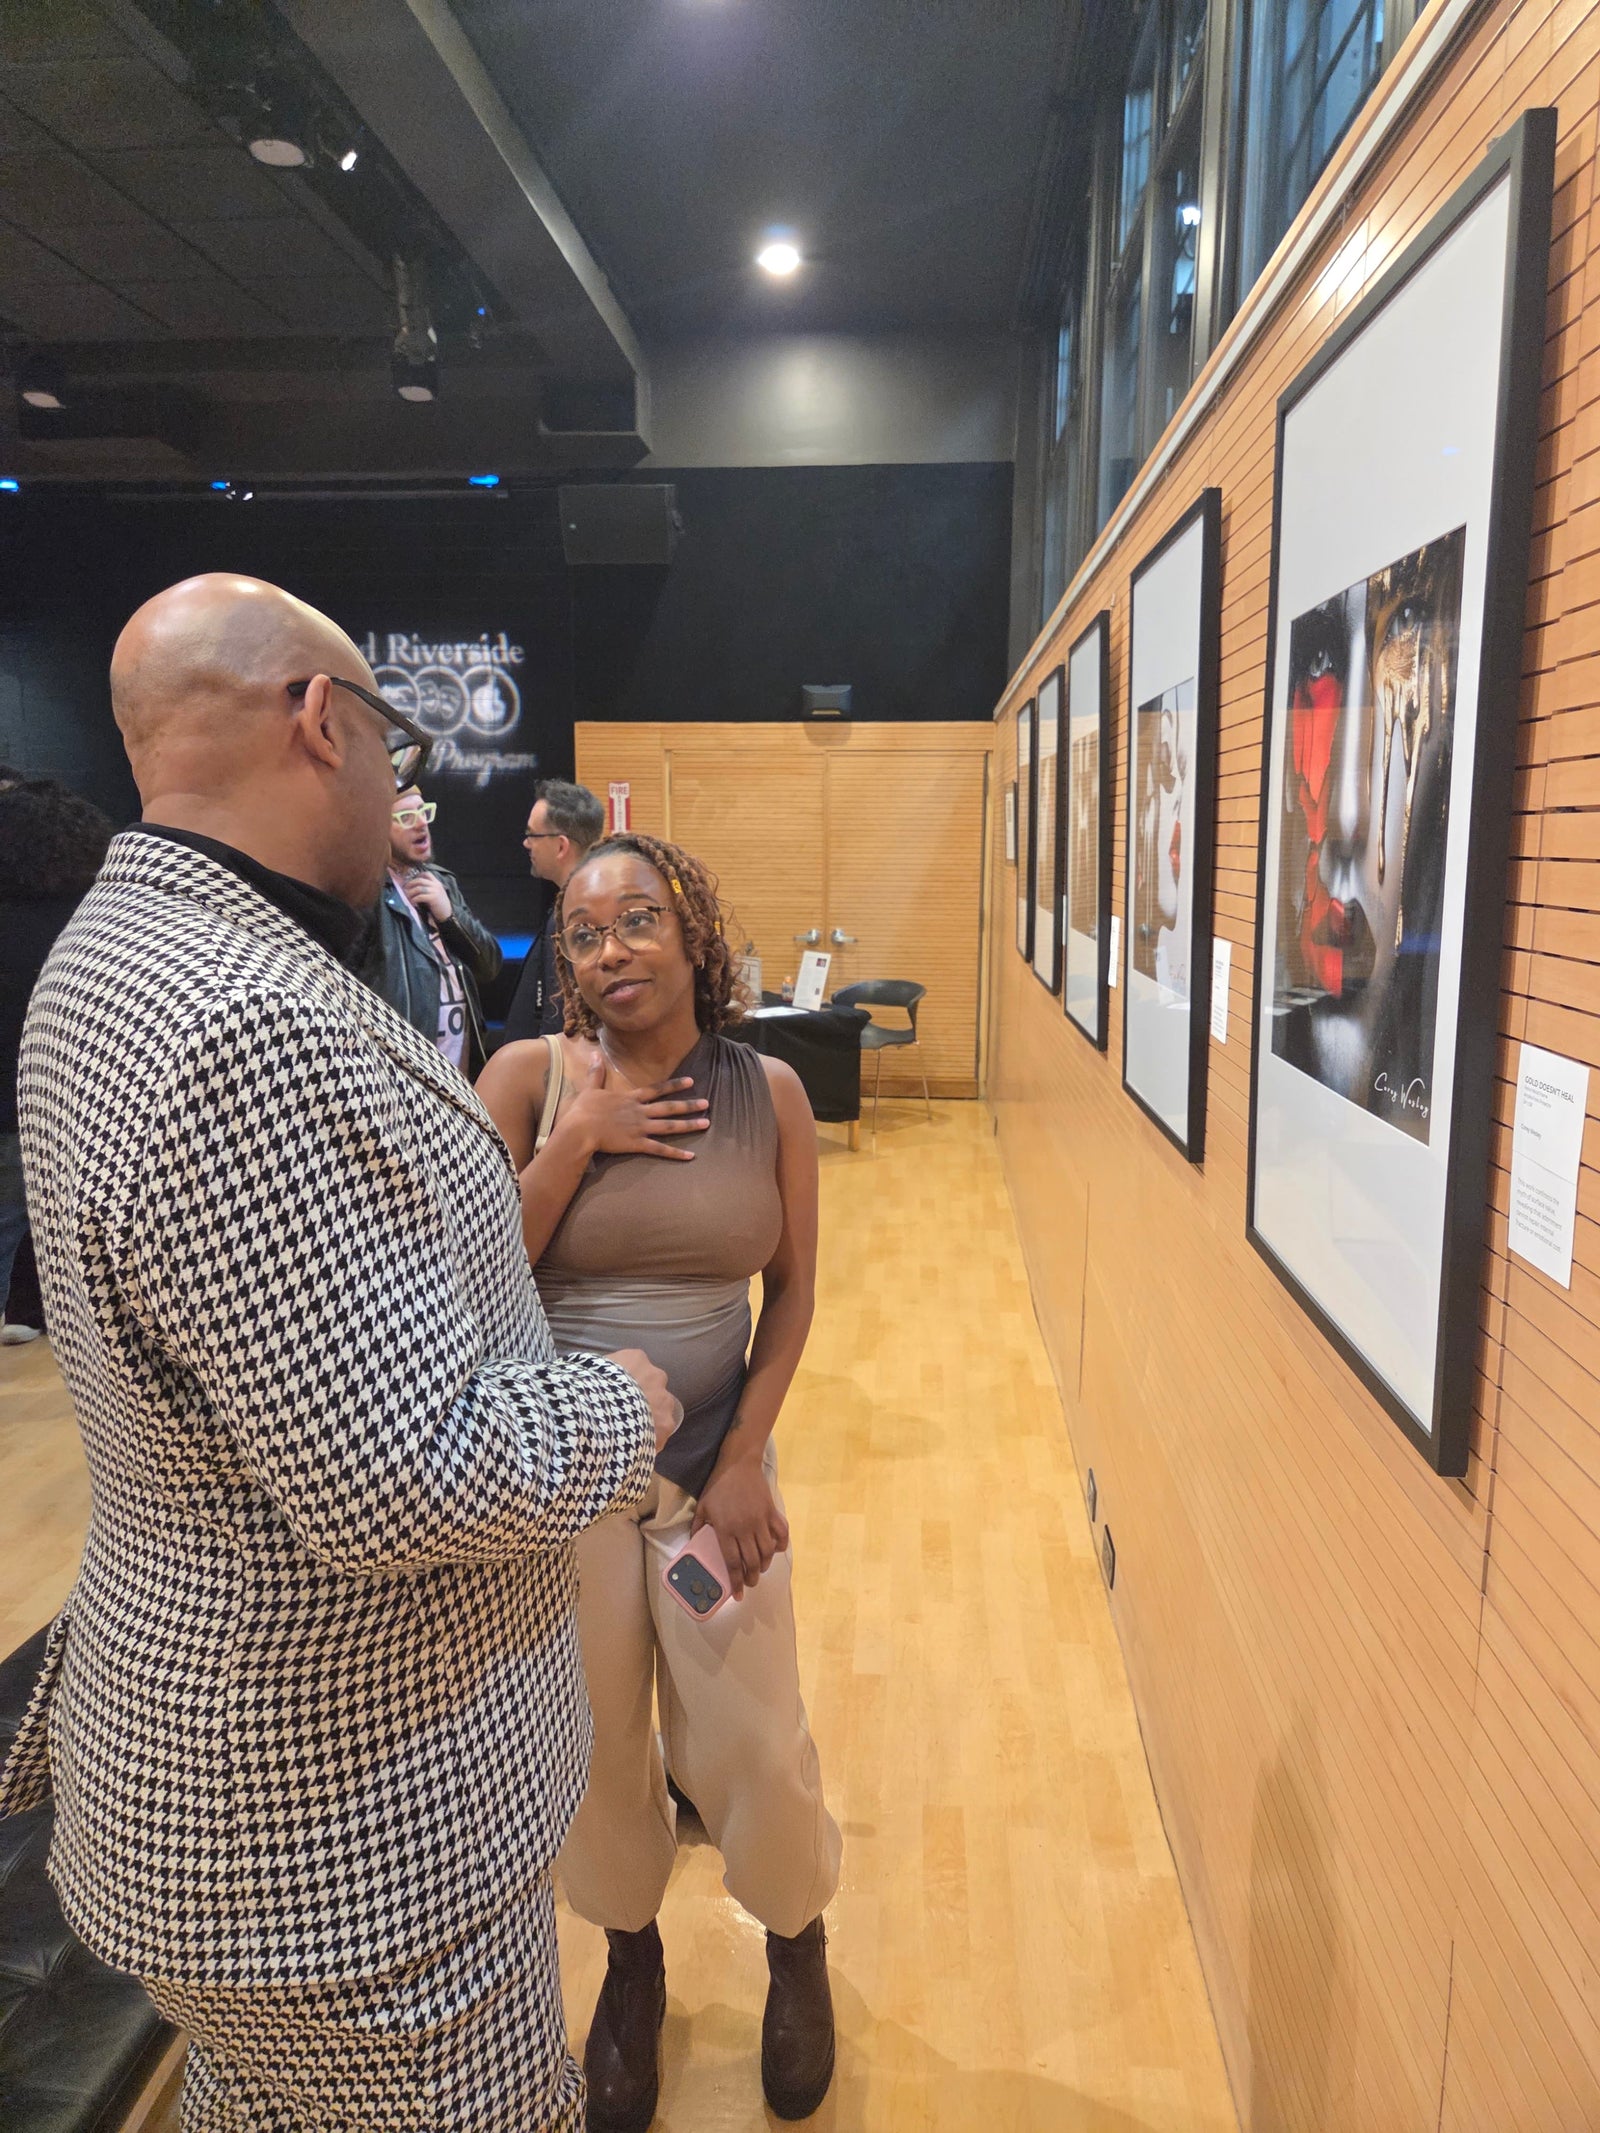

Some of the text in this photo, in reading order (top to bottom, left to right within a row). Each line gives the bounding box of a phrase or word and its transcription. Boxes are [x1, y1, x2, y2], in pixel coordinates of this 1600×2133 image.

[387, 632, 525, 664] Riverside
[611, 786, 628, 795] FIRE
[1539, 1081, 1561, 1096] DOESN'T
[1561, 1090, 1575, 1104] HEAL
